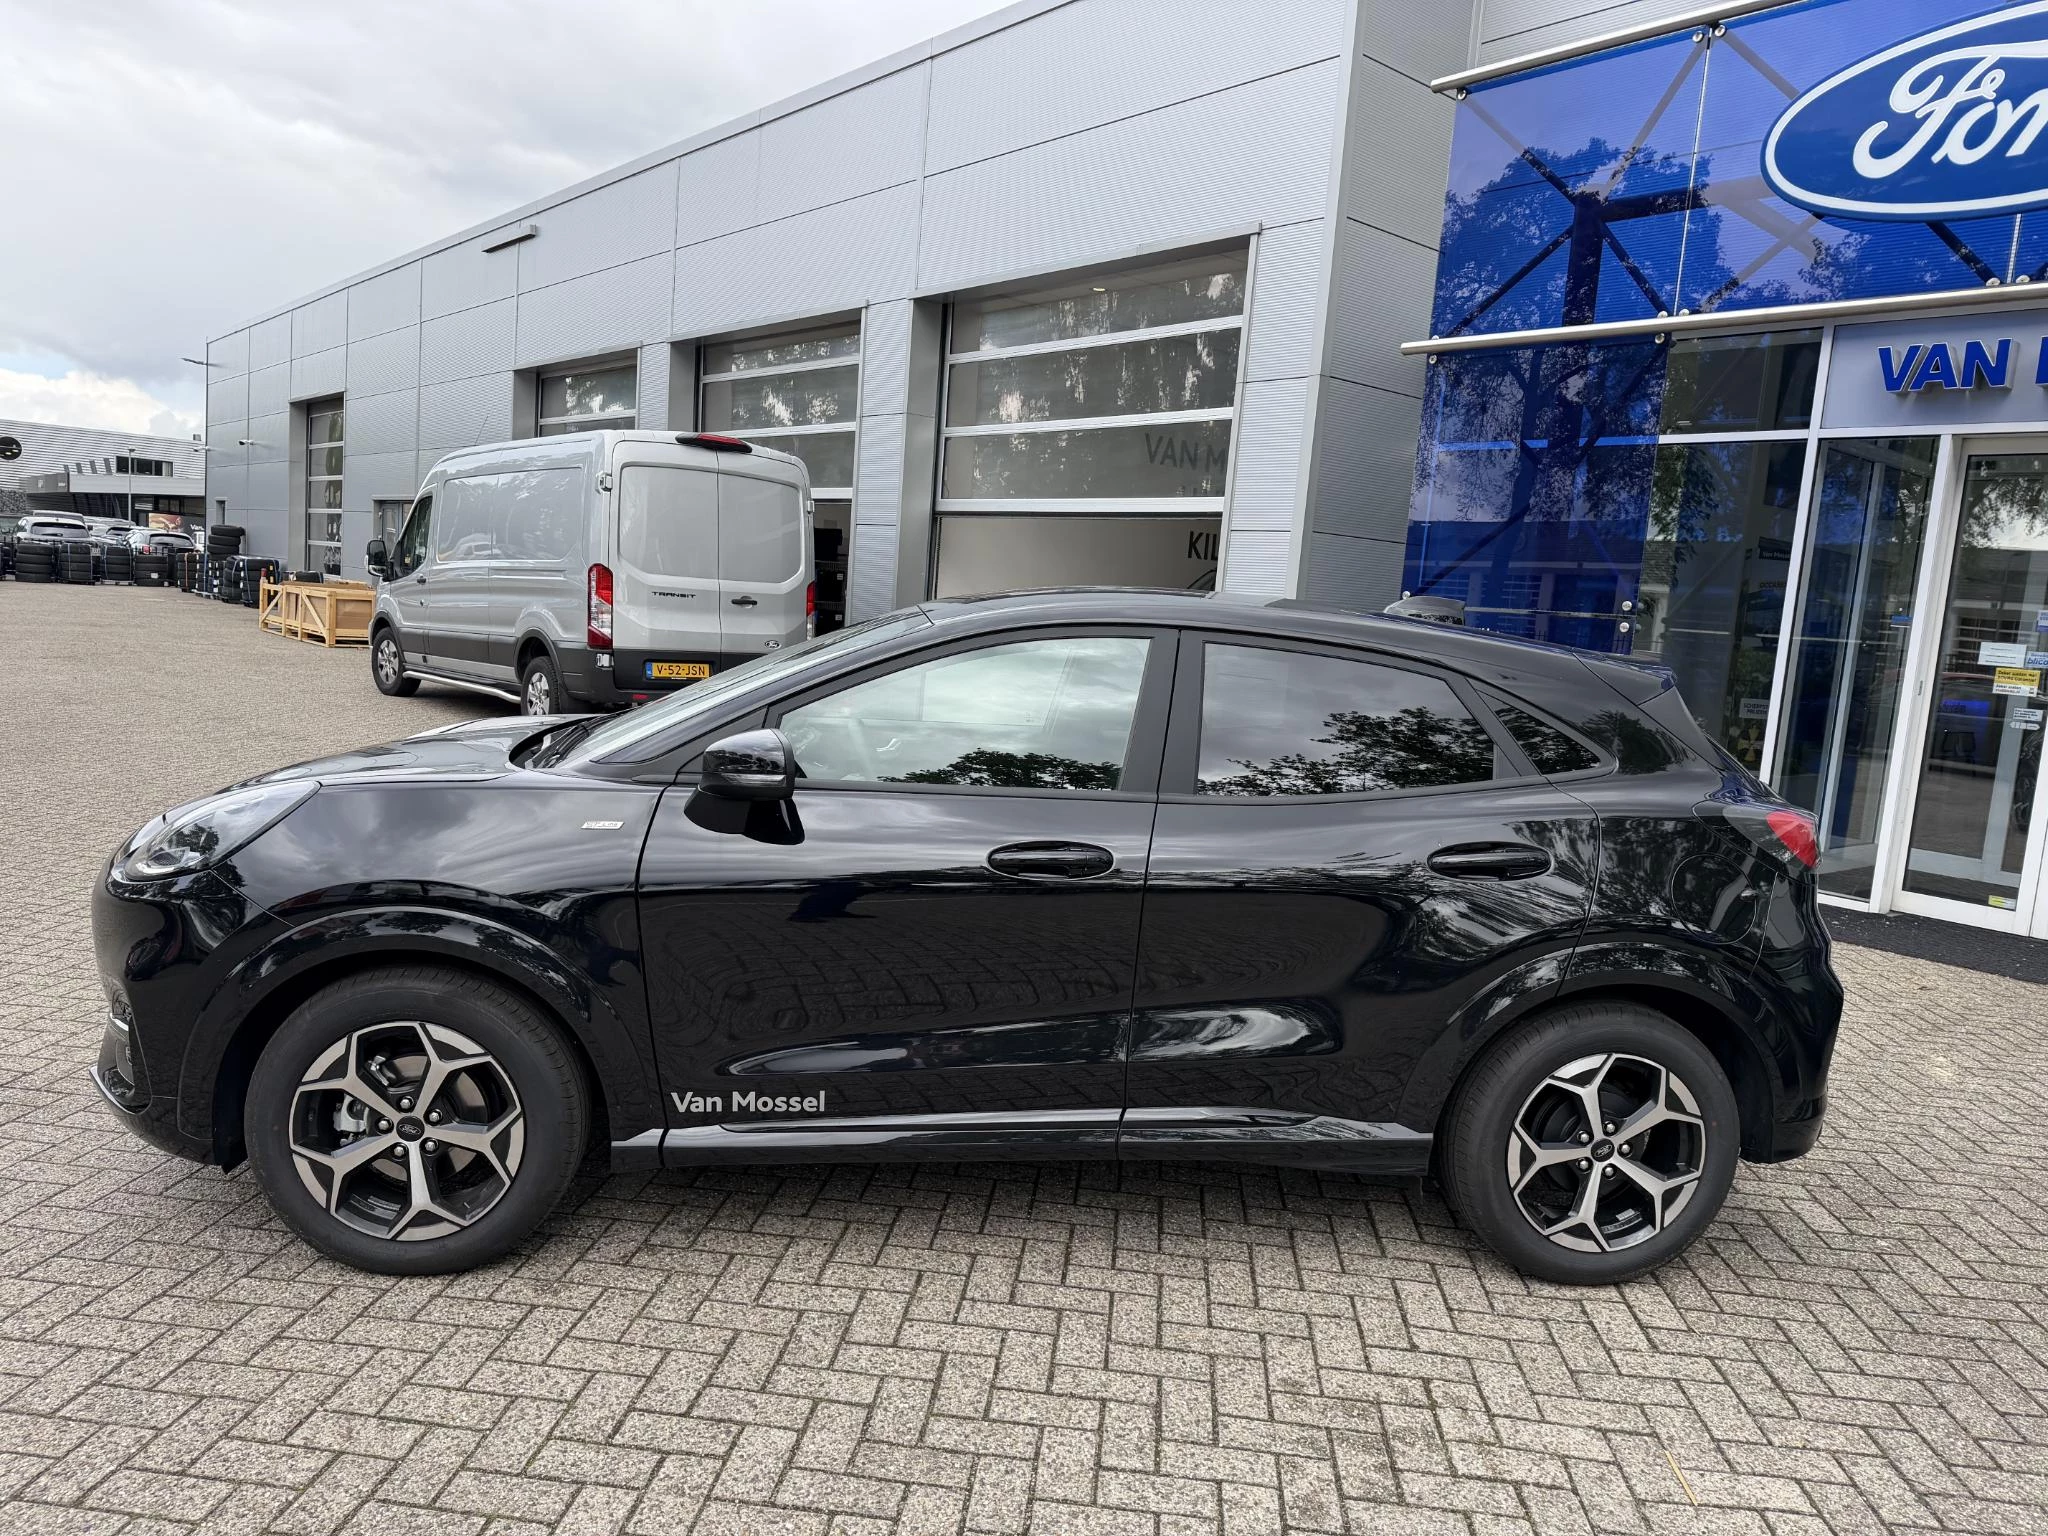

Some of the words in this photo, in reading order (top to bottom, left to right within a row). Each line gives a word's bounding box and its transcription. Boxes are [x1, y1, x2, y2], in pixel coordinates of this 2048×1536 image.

[1877, 337, 2014, 393] VAN
[1144, 432, 1199, 470] VAN
[651, 591, 697, 599] TRANSIT
[656, 664, 705, 676] V-52-JSN
[670, 1091, 723, 1113] Van
[732, 1090, 826, 1113] Mossel
